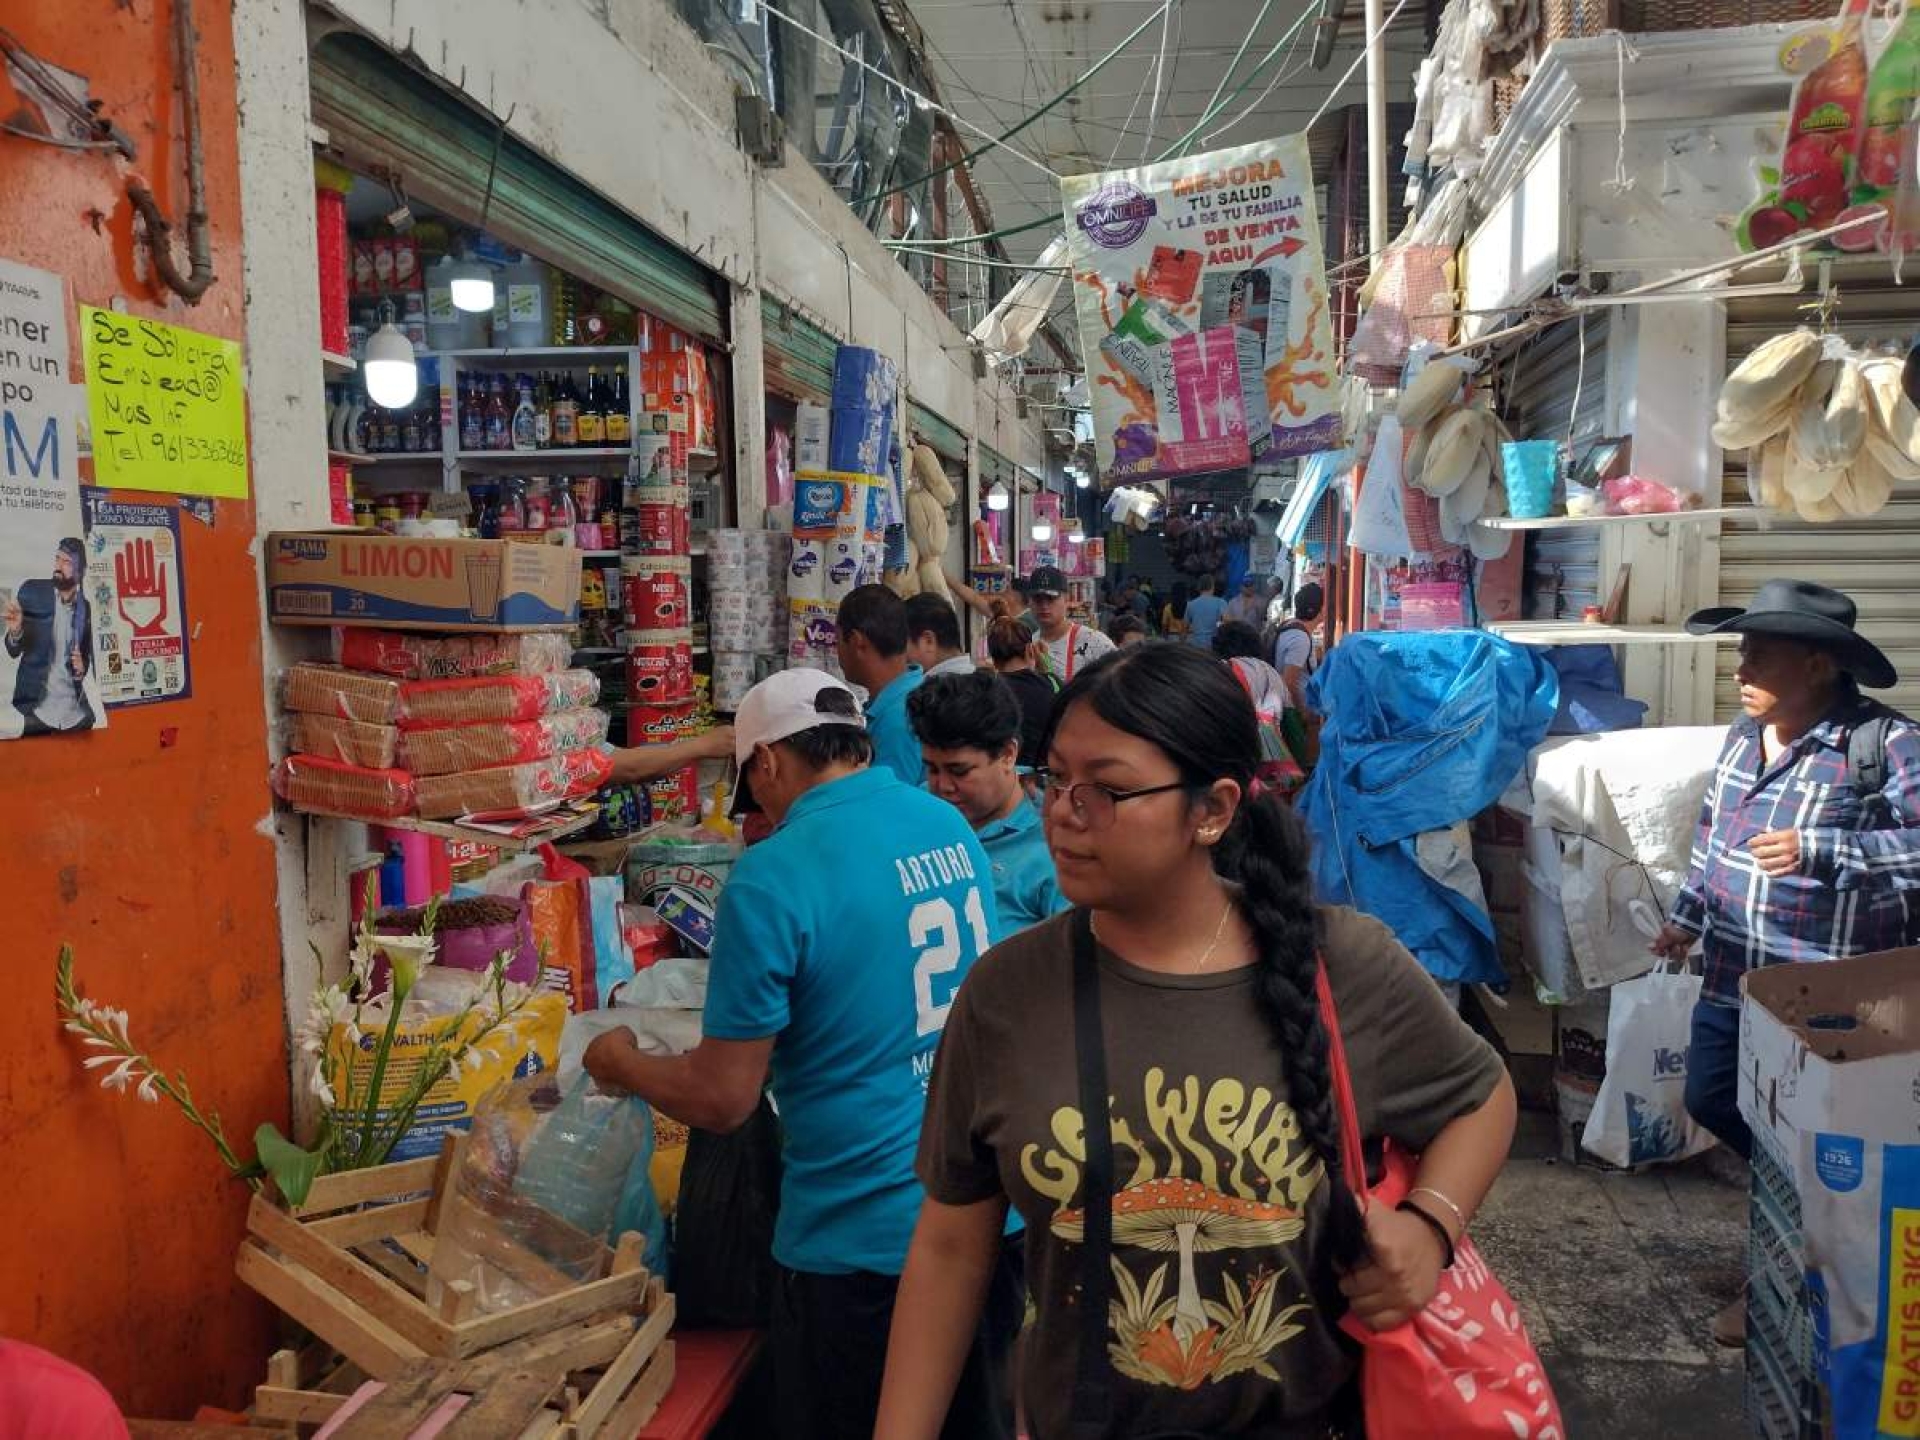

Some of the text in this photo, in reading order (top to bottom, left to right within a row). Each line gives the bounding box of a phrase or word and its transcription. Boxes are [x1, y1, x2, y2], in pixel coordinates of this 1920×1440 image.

[1173, 159, 1286, 197] MEJORA
[1163, 194, 1303, 231] Y LA DE TU FAMILIA
[1188, 185, 1272, 211] TU SALUD
[1204, 215, 1301, 246] DE VENTA
[1207, 244, 1255, 266] AQUI
[0, 316, 50, 344] ner
[92, 311, 132, 346] Se
[29, 354, 59, 377] un
[2, 381, 33, 403] po
[103, 430, 143, 461] Tel
[6, 499, 18, 507] tu
[23, 487, 38, 498] de
[39, 489, 67, 500] tener
[339, 544, 455, 579] LIMON
[895, 842, 976, 896] ARTURO
[1893, 1302, 1920, 1422] GRATIS
